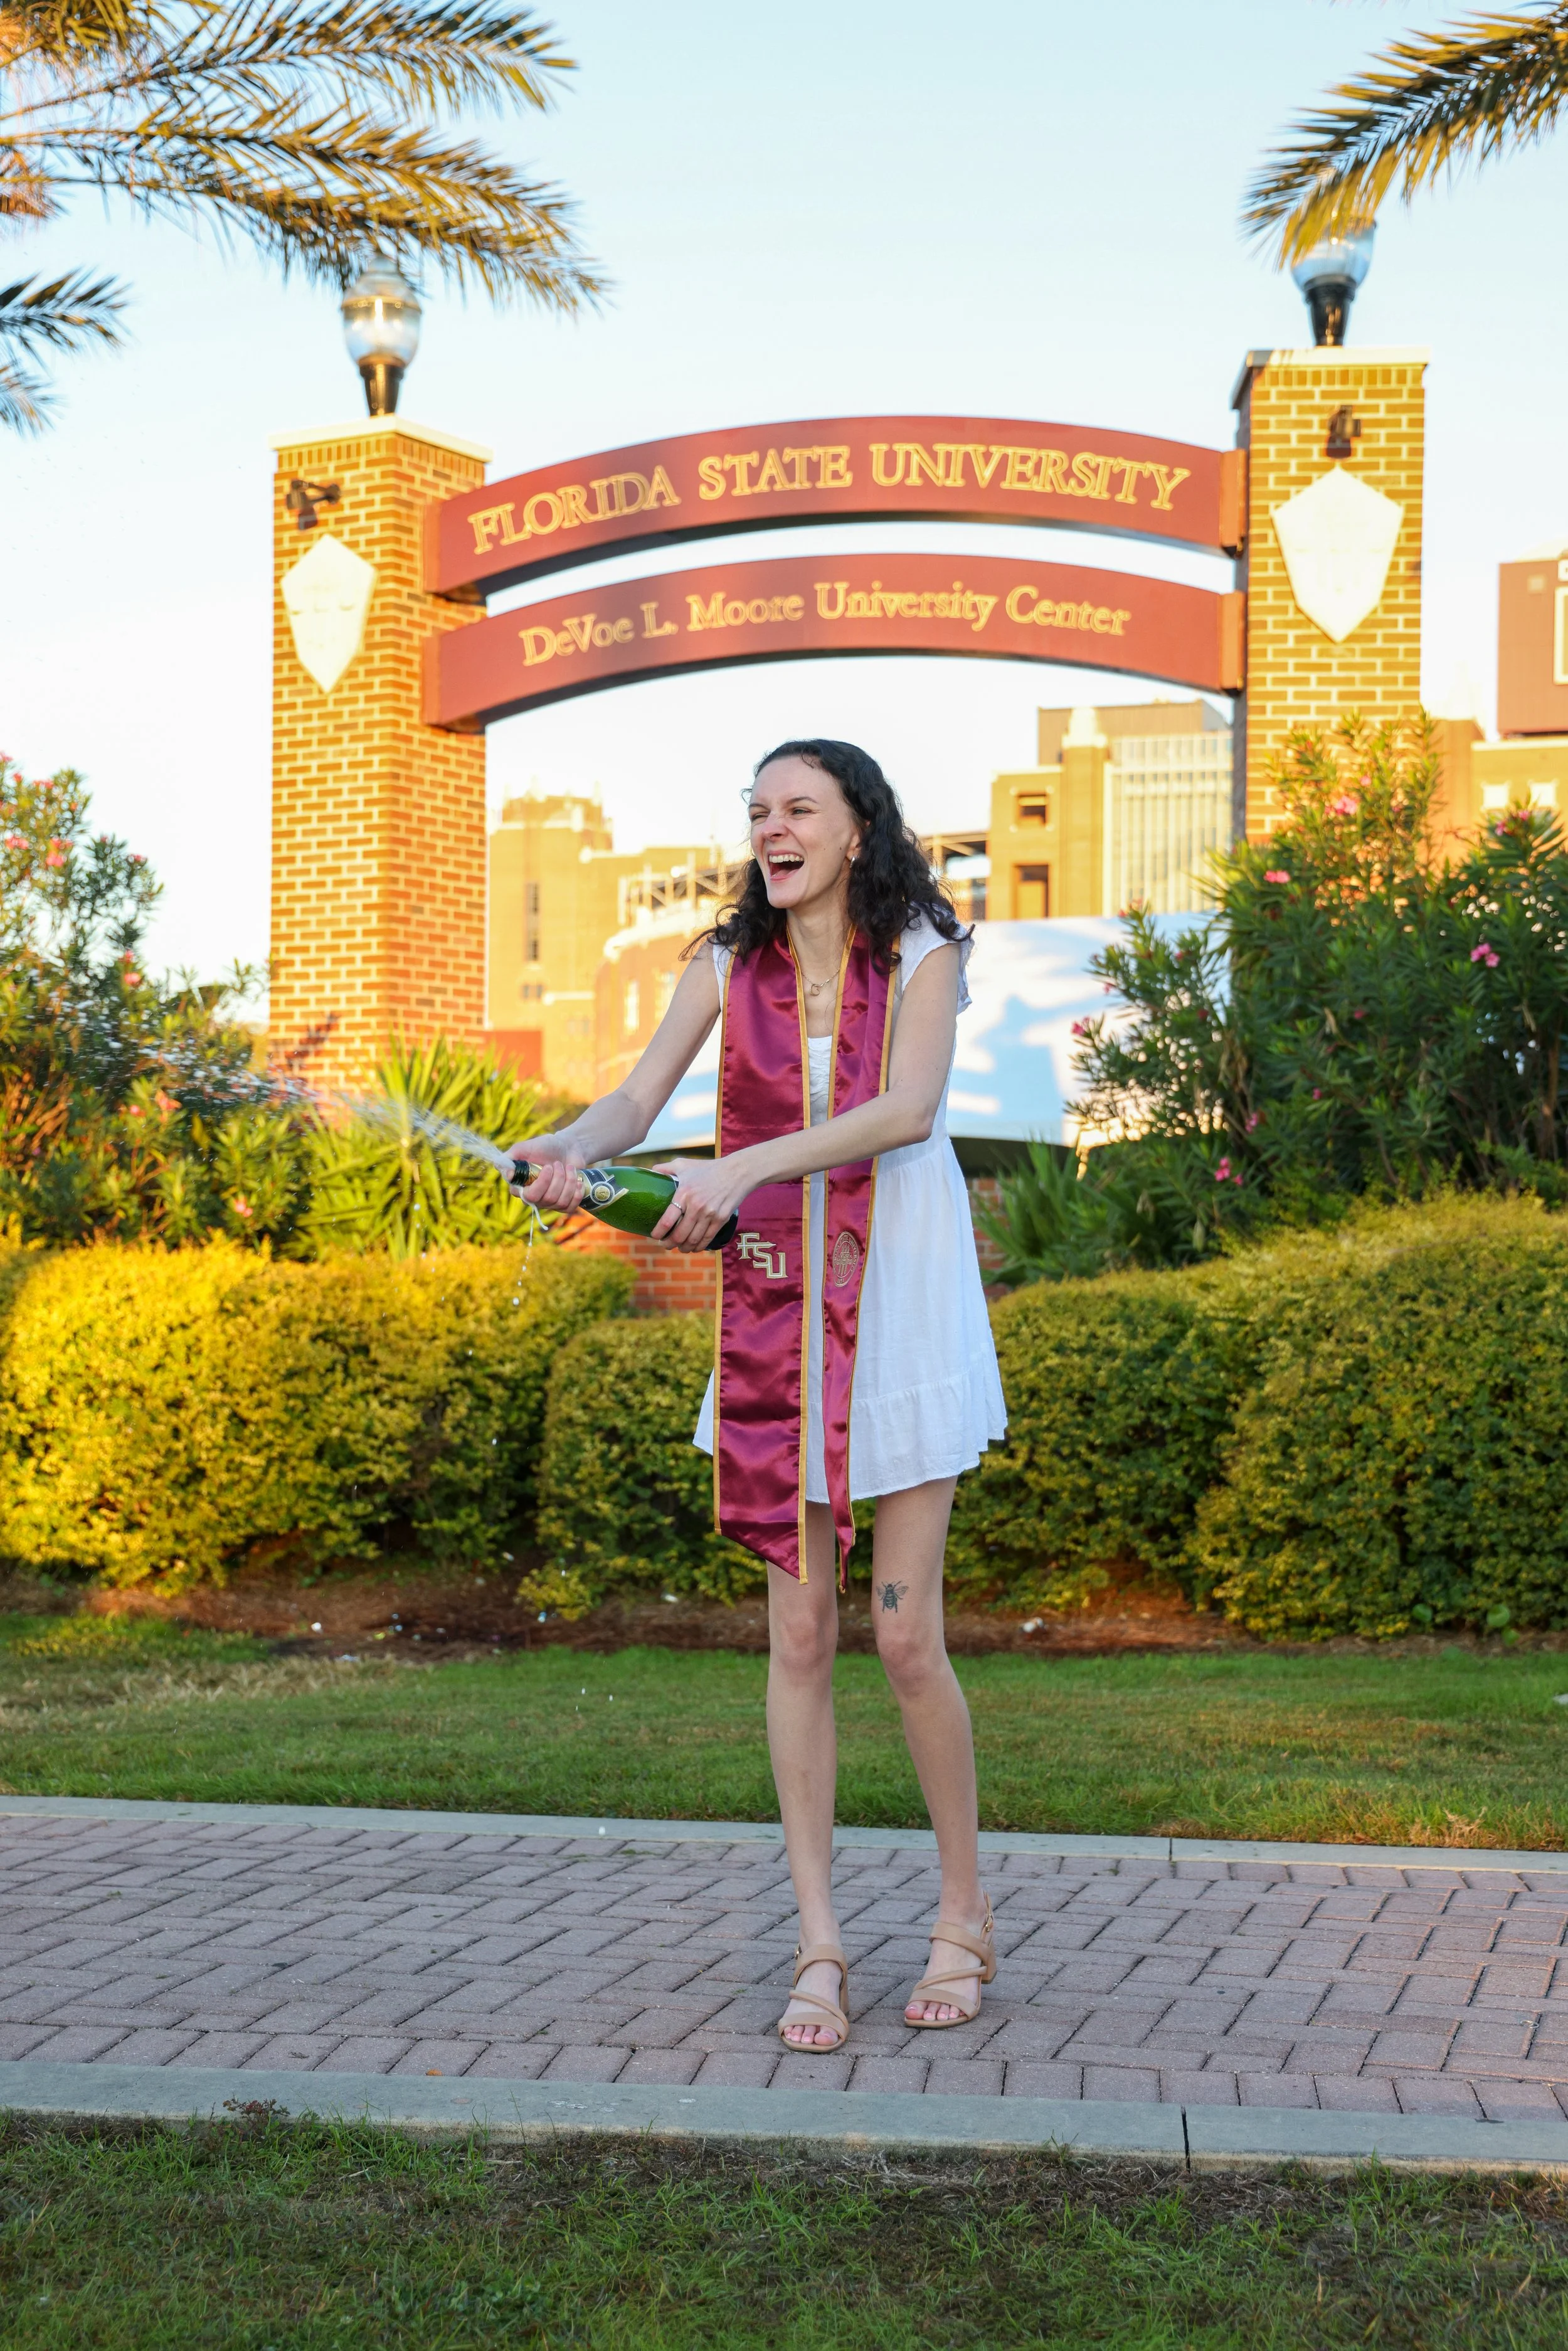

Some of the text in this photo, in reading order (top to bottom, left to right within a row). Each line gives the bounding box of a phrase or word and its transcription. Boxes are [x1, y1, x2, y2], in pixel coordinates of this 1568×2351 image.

[468, 443, 1190, 554] FLORIDA STATE UNIVERSITY
[519, 613, 634, 666] DeVoe
[686, 592, 804, 632] Moore
[814, 580, 999, 632] University
[1005, 584, 1131, 637] Center
[736, 1233, 788, 1278] FSU
